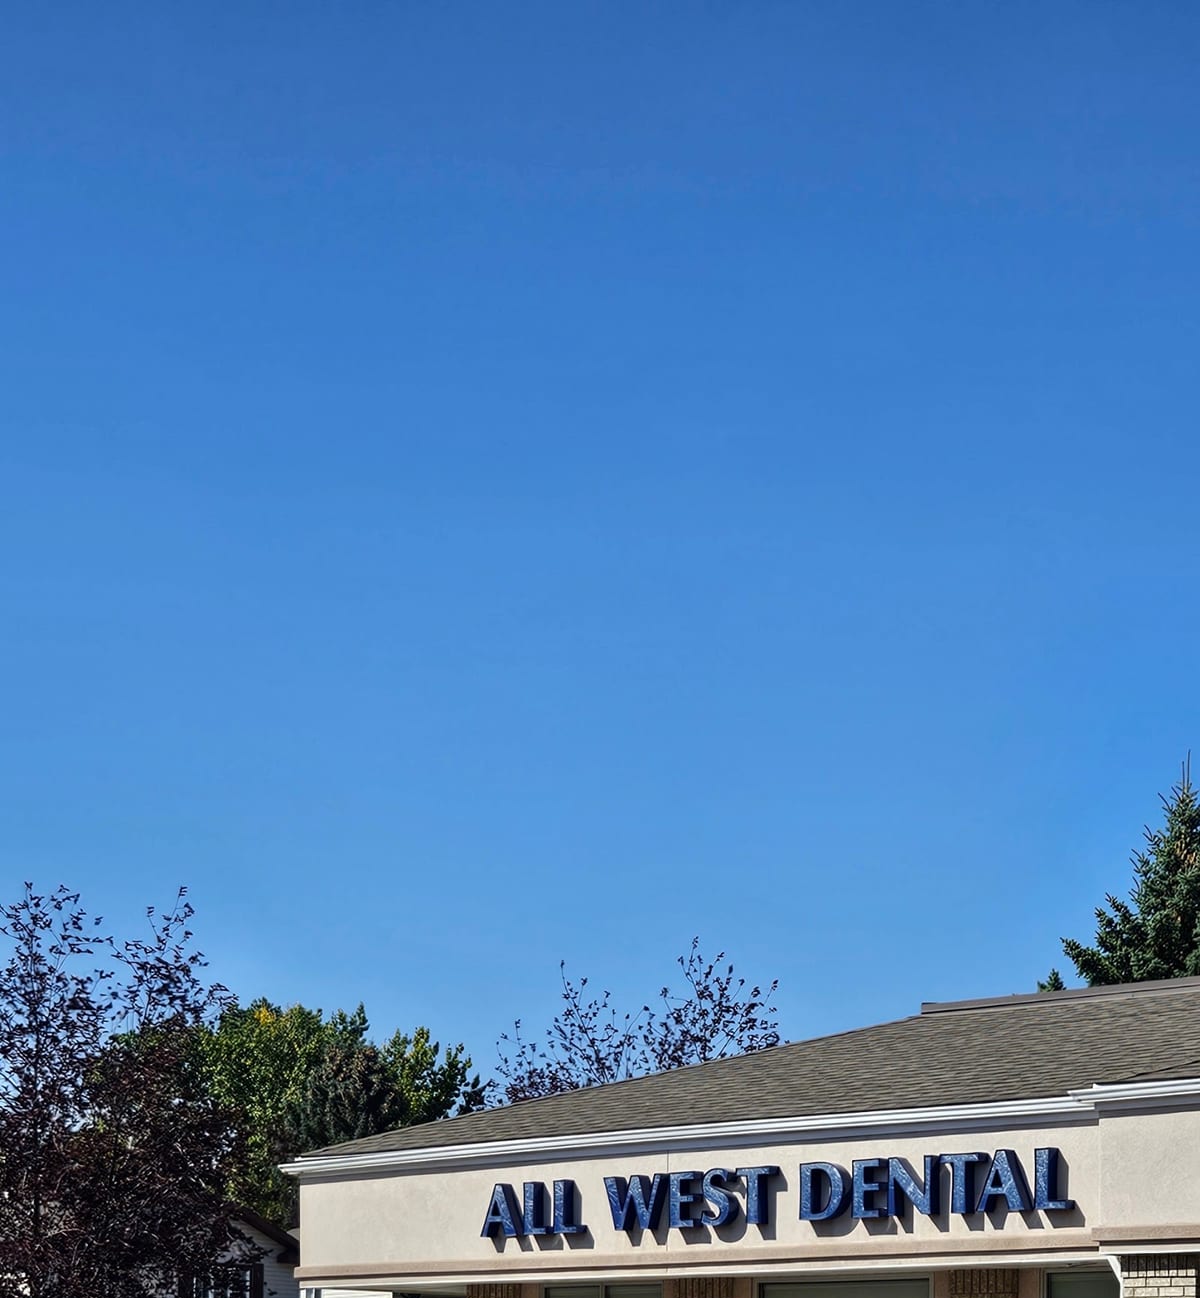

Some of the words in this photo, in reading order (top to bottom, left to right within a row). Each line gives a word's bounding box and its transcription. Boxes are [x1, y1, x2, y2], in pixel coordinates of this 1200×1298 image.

[480, 1179, 586, 1238] ALL
[603, 1165, 780, 1231] WEST
[798, 1147, 1076, 1222] DENTAL
